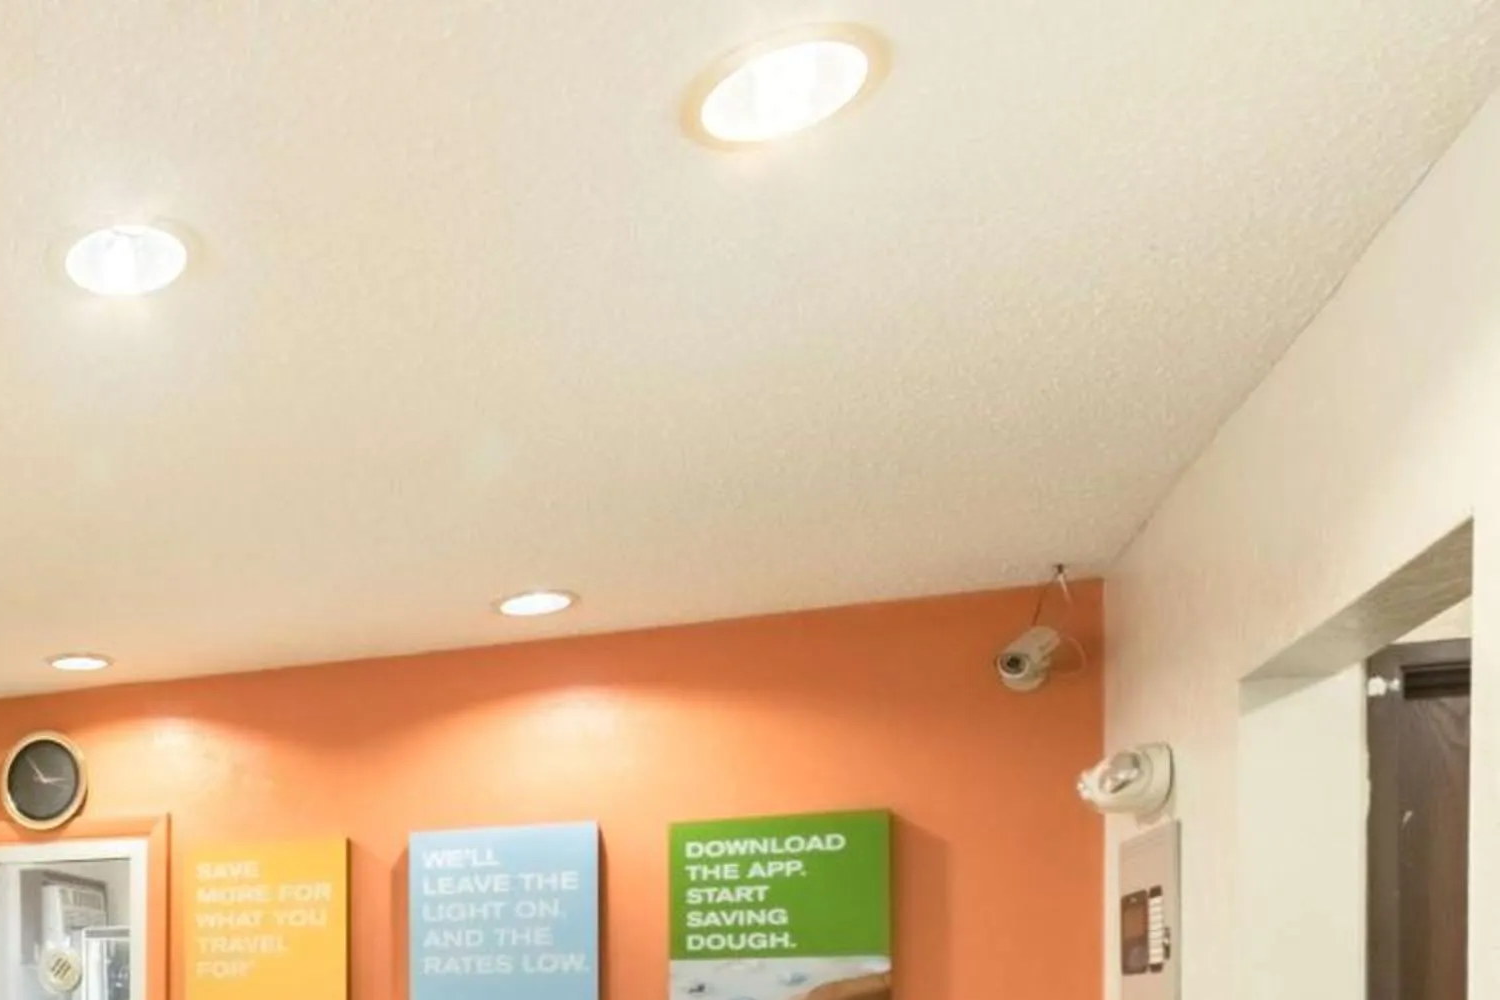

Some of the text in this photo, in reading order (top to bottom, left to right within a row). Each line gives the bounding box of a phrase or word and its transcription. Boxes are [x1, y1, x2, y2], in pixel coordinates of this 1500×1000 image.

[685, 833, 847, 859] DOWNLOAD
[422, 848, 500, 869] WE'LL
[196, 860, 260, 880] SAVE
[685, 860, 807, 881] THE APP.
[278, 881, 332, 902] FOR
[422, 870, 580, 896] LEAVE THE
[686, 885, 770, 905] START
[195, 908, 328, 928] WHAT YOU
[422, 900, 506, 922] LIGHT
[686, 908, 789, 928] SAVING
[197, 935, 289, 954] TRAVEL
[422, 925, 554, 948] AND THE
[686, 931, 797, 952] DOUGH.
[422, 952, 590, 975] RATES LOW.
